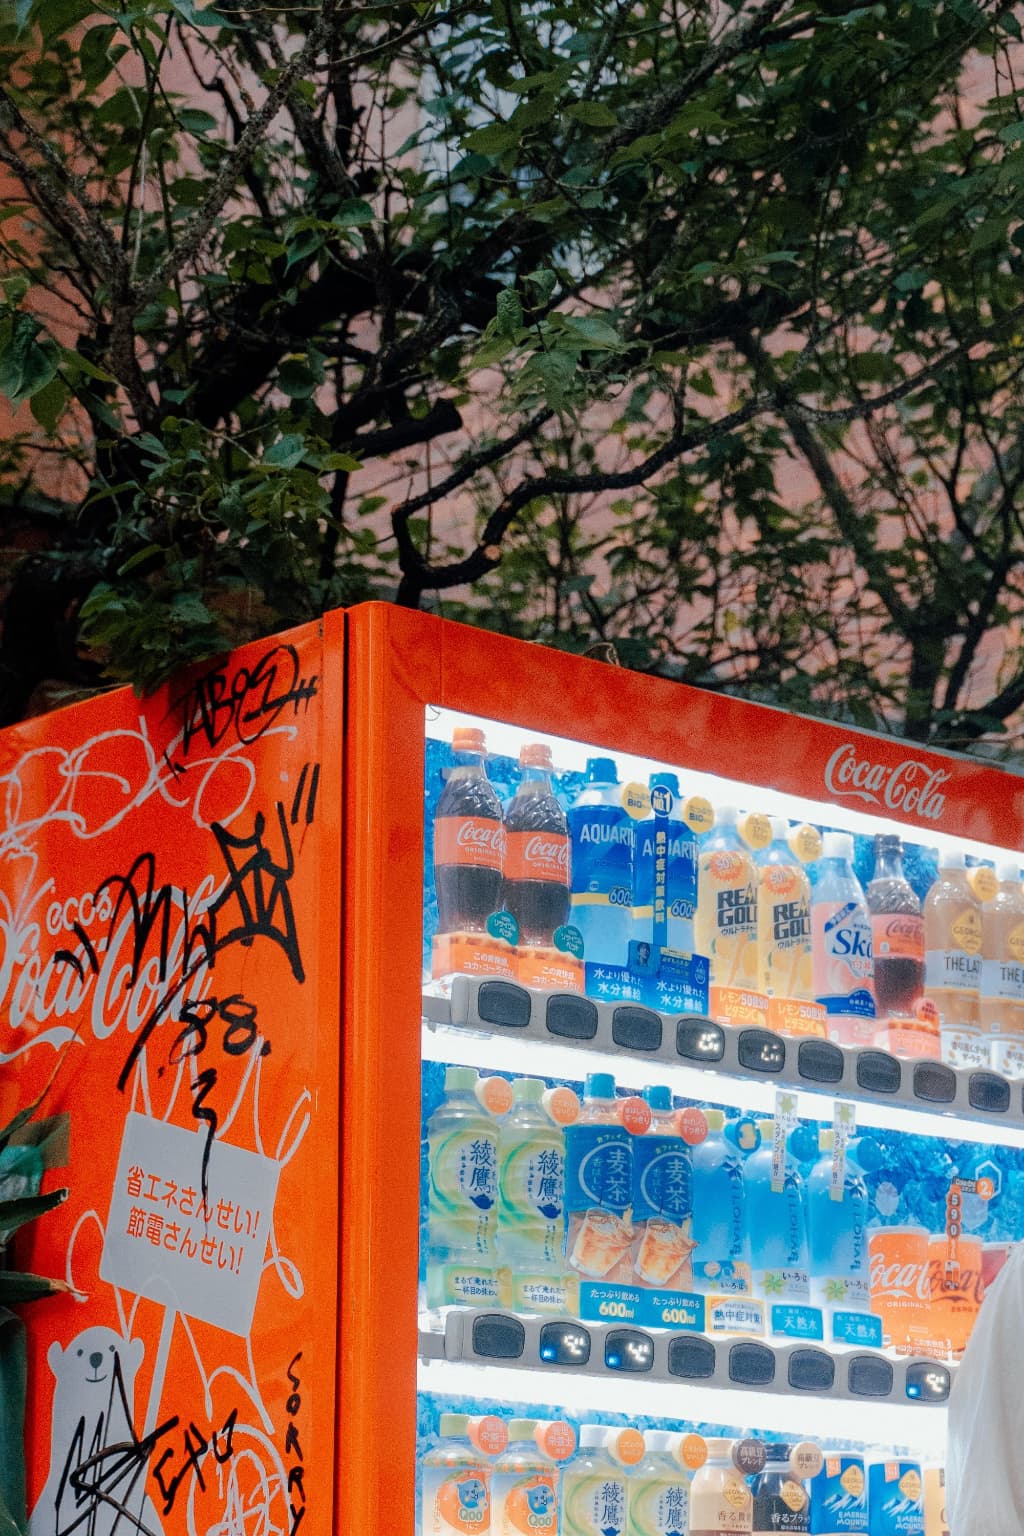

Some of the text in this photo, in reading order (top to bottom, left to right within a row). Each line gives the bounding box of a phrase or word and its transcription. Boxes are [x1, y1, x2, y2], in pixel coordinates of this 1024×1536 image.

[825, 743, 952, 821] Coca-Cola
[774, 921, 810, 941] GOL
[945, 956, 963, 972] THE
[1000, 967, 1020, 982] THE
[470, 1139, 492, 1193] 綾鷹
[537, 1150, 560, 1203] 綾鷹
[605, 1149, 628, 1202] 麦茶
[665, 1158, 688, 1211] 麦茶
[127, 1165, 259, 1238] 省エネさんせい!
[126, 1206, 243, 1274] 節電さんせい!
[591, 1289, 640, 1303] たっぷり飲める
[599, 1302, 634, 1319] 600ml
[653, 1296, 700, 1310] たっぷり飲める
[662, 1309, 696, 1325] 600ml
[459, 1509, 483, 1523] Qoo
[602, 1482, 620, 1525] 綾鷹
[665, 1487, 683, 1529] 綾鷹
[528, 1514, 552, 1528] Qoo
